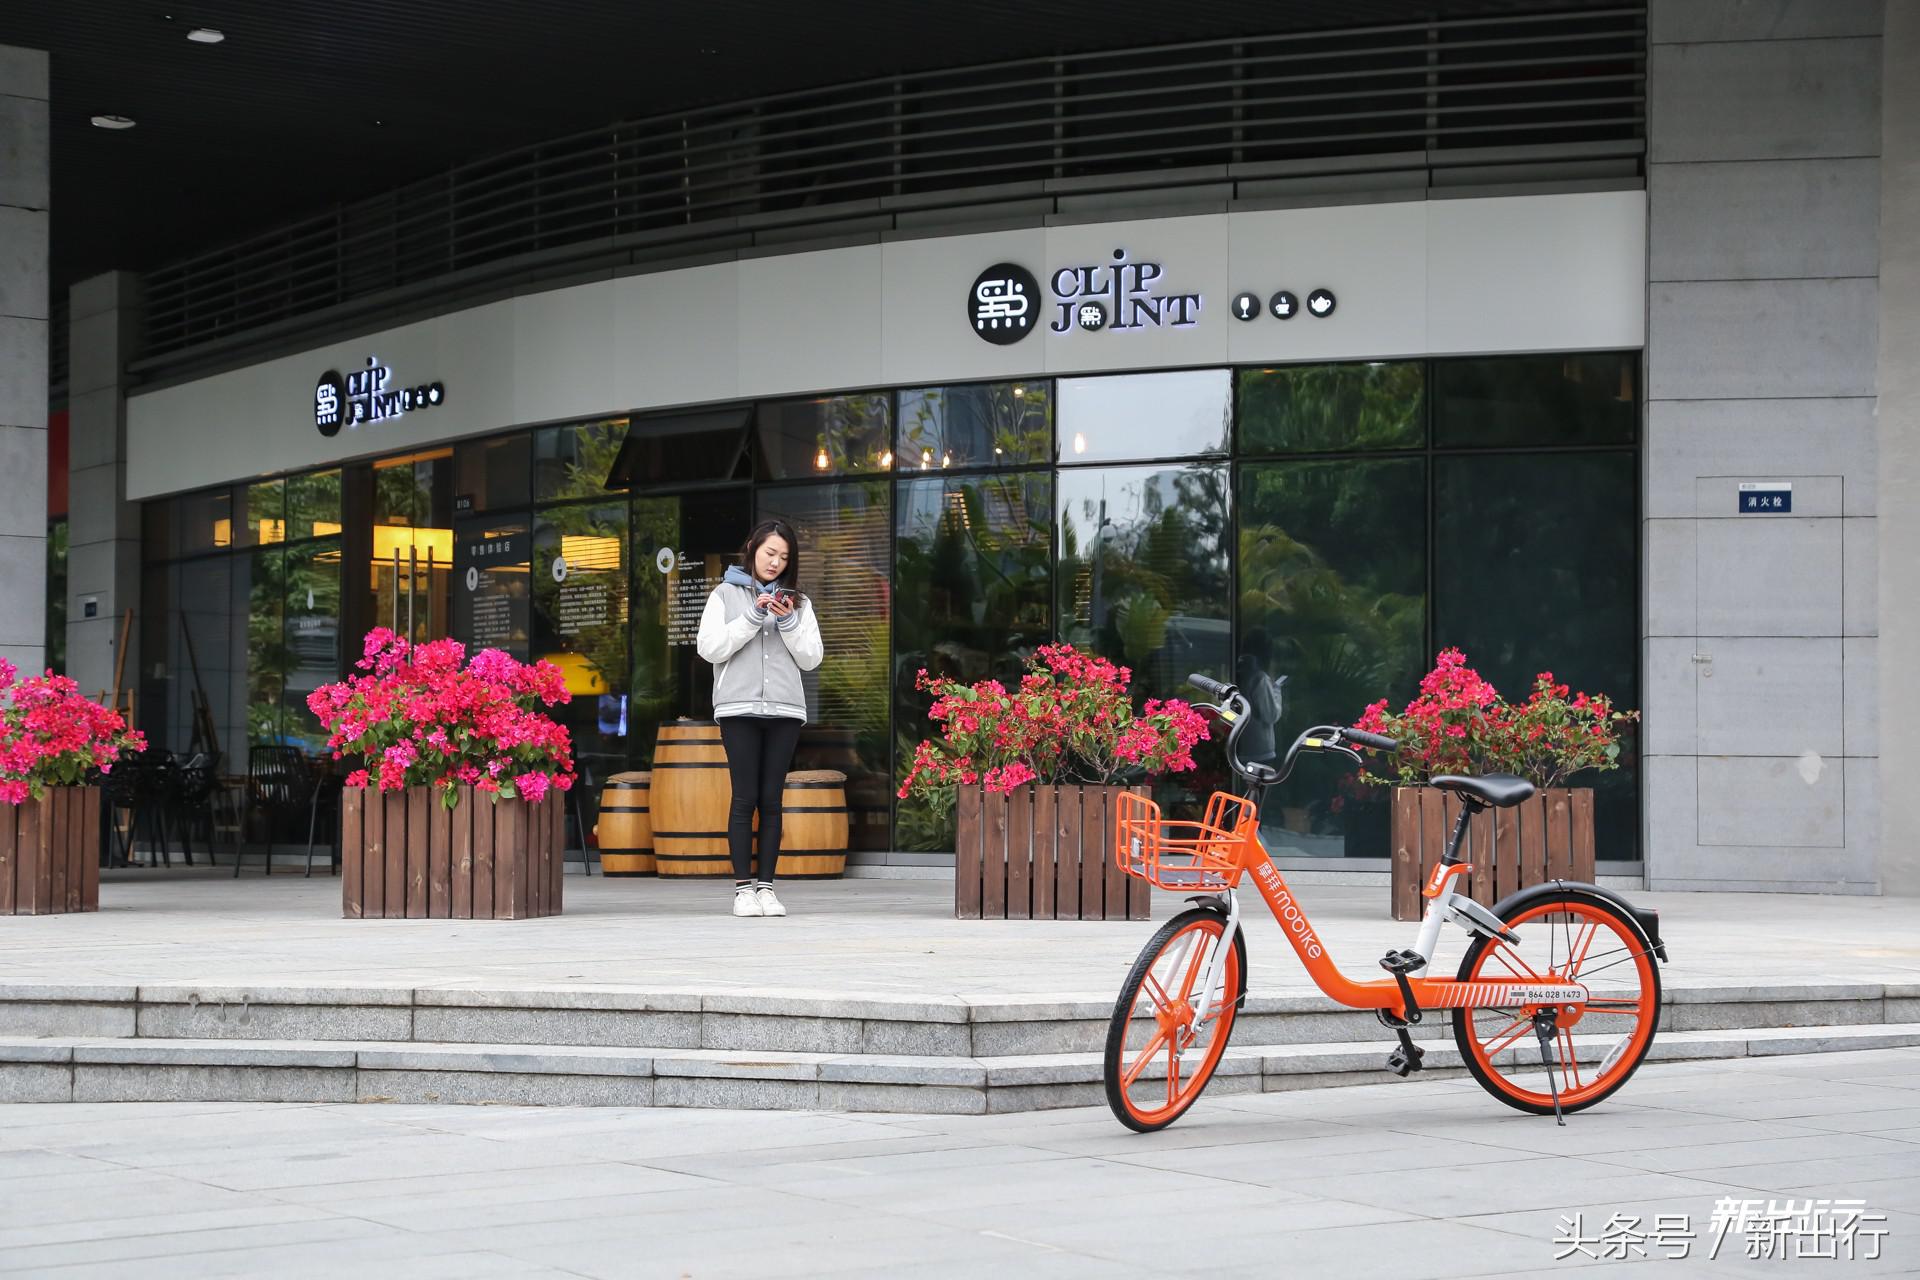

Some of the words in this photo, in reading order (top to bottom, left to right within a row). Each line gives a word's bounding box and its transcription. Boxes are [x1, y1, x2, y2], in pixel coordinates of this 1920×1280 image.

[1748, 496, 1783, 507] 消火栓
[1273, 890, 1322, 959] mobike
[1528, 990, 1543, 999] 864
[1545, 990, 1560, 999] 028
[1562, 990, 1581, 999] 1473
